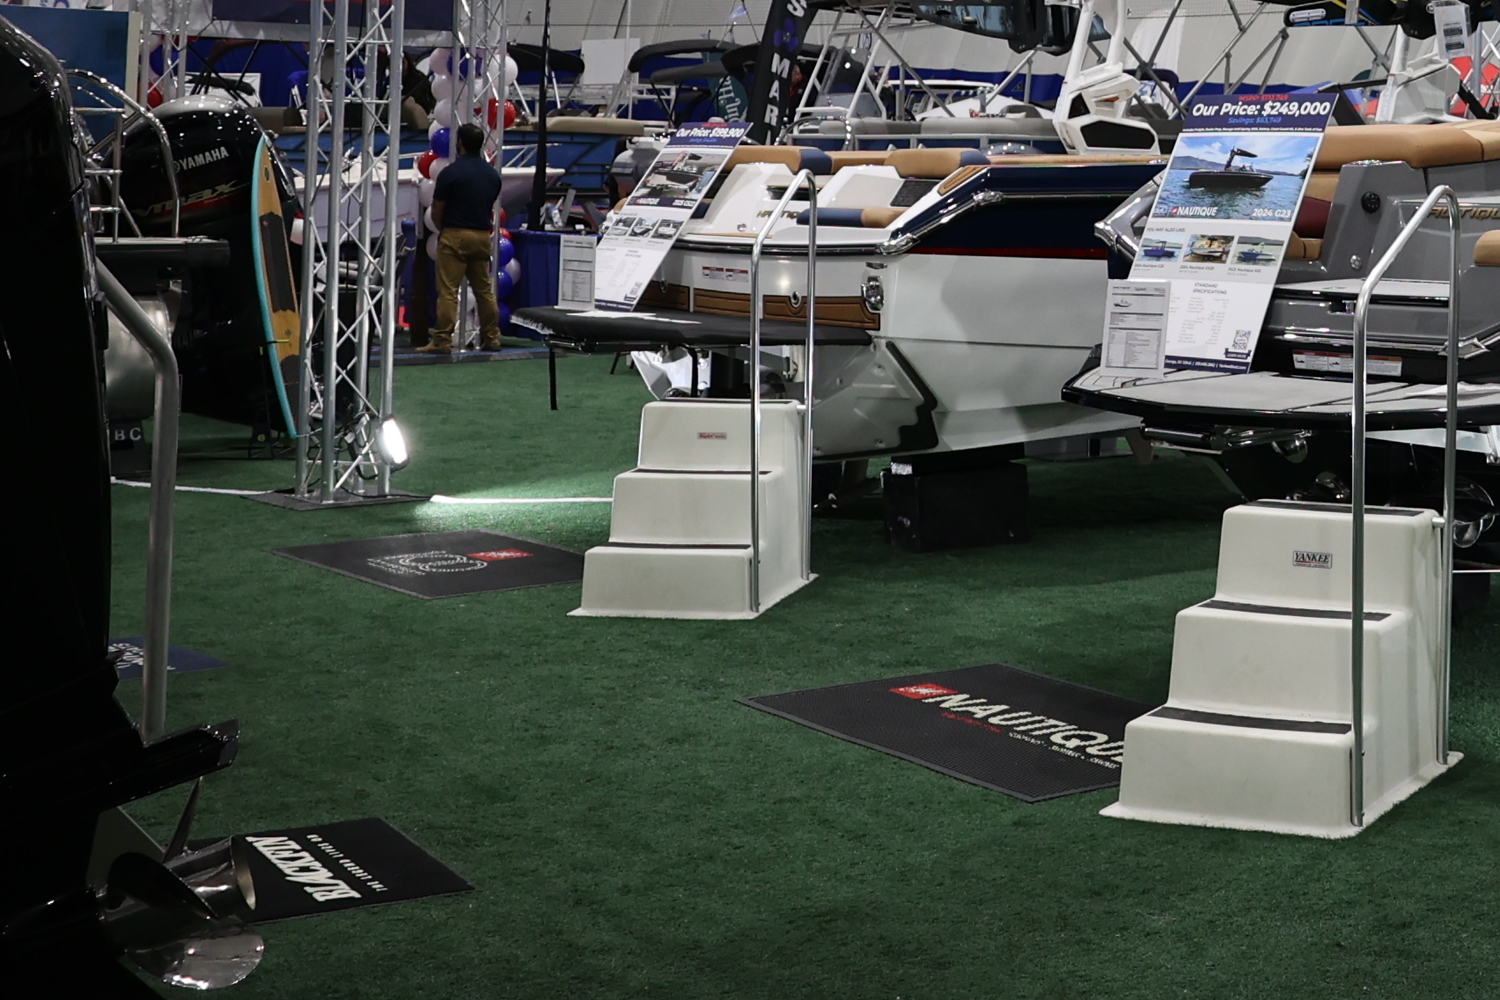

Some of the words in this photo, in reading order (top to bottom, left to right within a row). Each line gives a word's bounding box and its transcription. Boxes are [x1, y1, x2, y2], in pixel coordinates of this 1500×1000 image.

[1192, 104, 1217, 116] Our
[1220, 101, 1260, 116] Price:
[1262, 101, 1331, 117] $249,000
[676, 128, 690, 138] Our
[180, 146, 230, 170] YAMAHA
[1177, 206, 1219, 217] NAUTIQUE
[1252, 208, 1273, 217] 2024
[1274, 209, 1292, 218] G23
[1295, 552, 1329, 563] YANKEE
[921, 693, 1124, 763] NAUTIQU
[245, 836, 362, 902] BLACKFIN
[338, 858, 373, 881] LEGEND
[366, 880, 389, 892] THE
